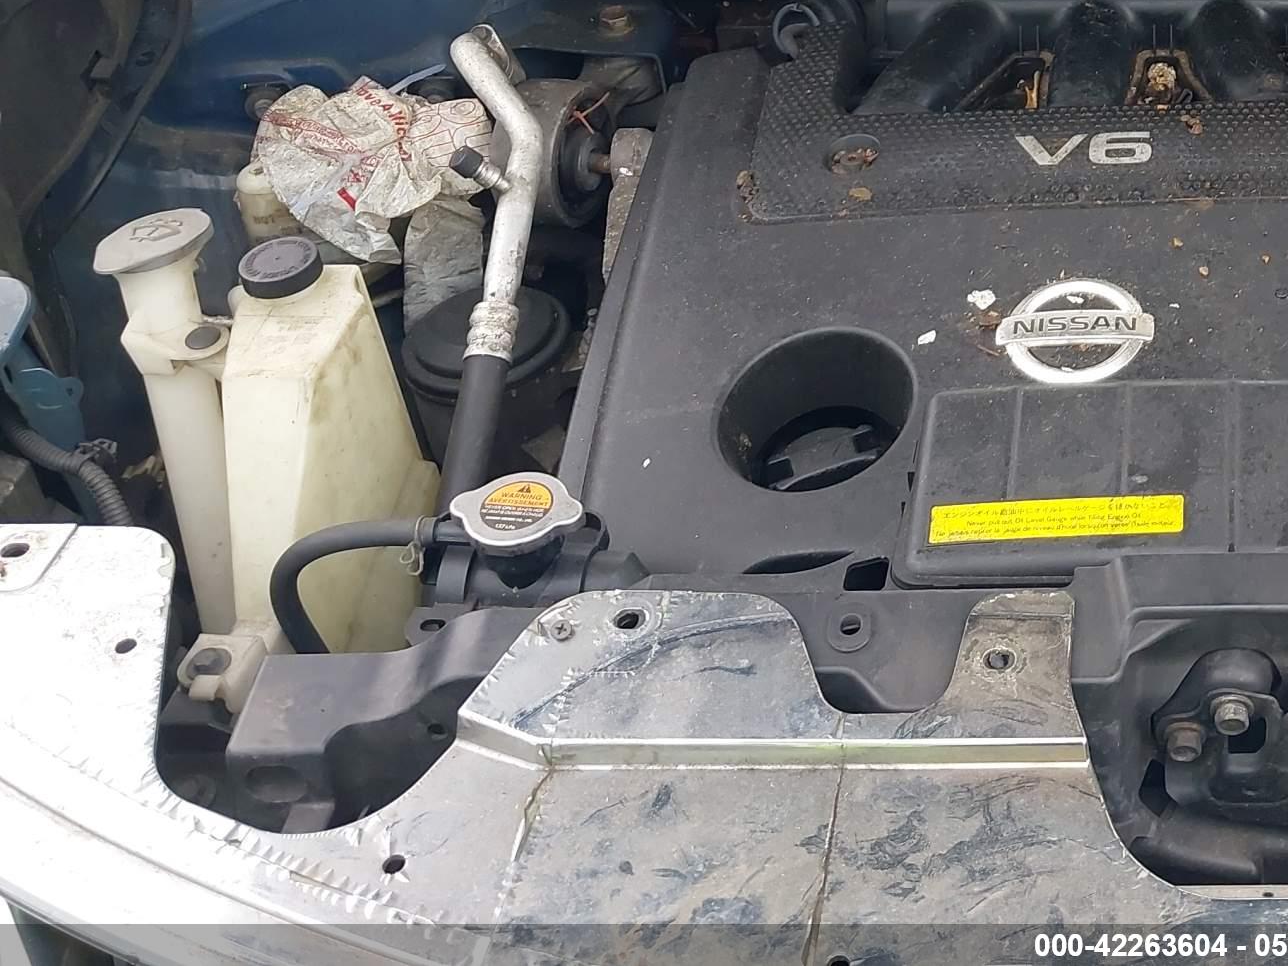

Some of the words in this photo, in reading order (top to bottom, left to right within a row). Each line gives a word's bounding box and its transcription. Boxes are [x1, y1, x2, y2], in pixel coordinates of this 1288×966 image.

[1015, 131, 1153, 166] V6
[1013, 315, 1137, 335] NISSAN
[501, 492, 543, 500] WARNING
